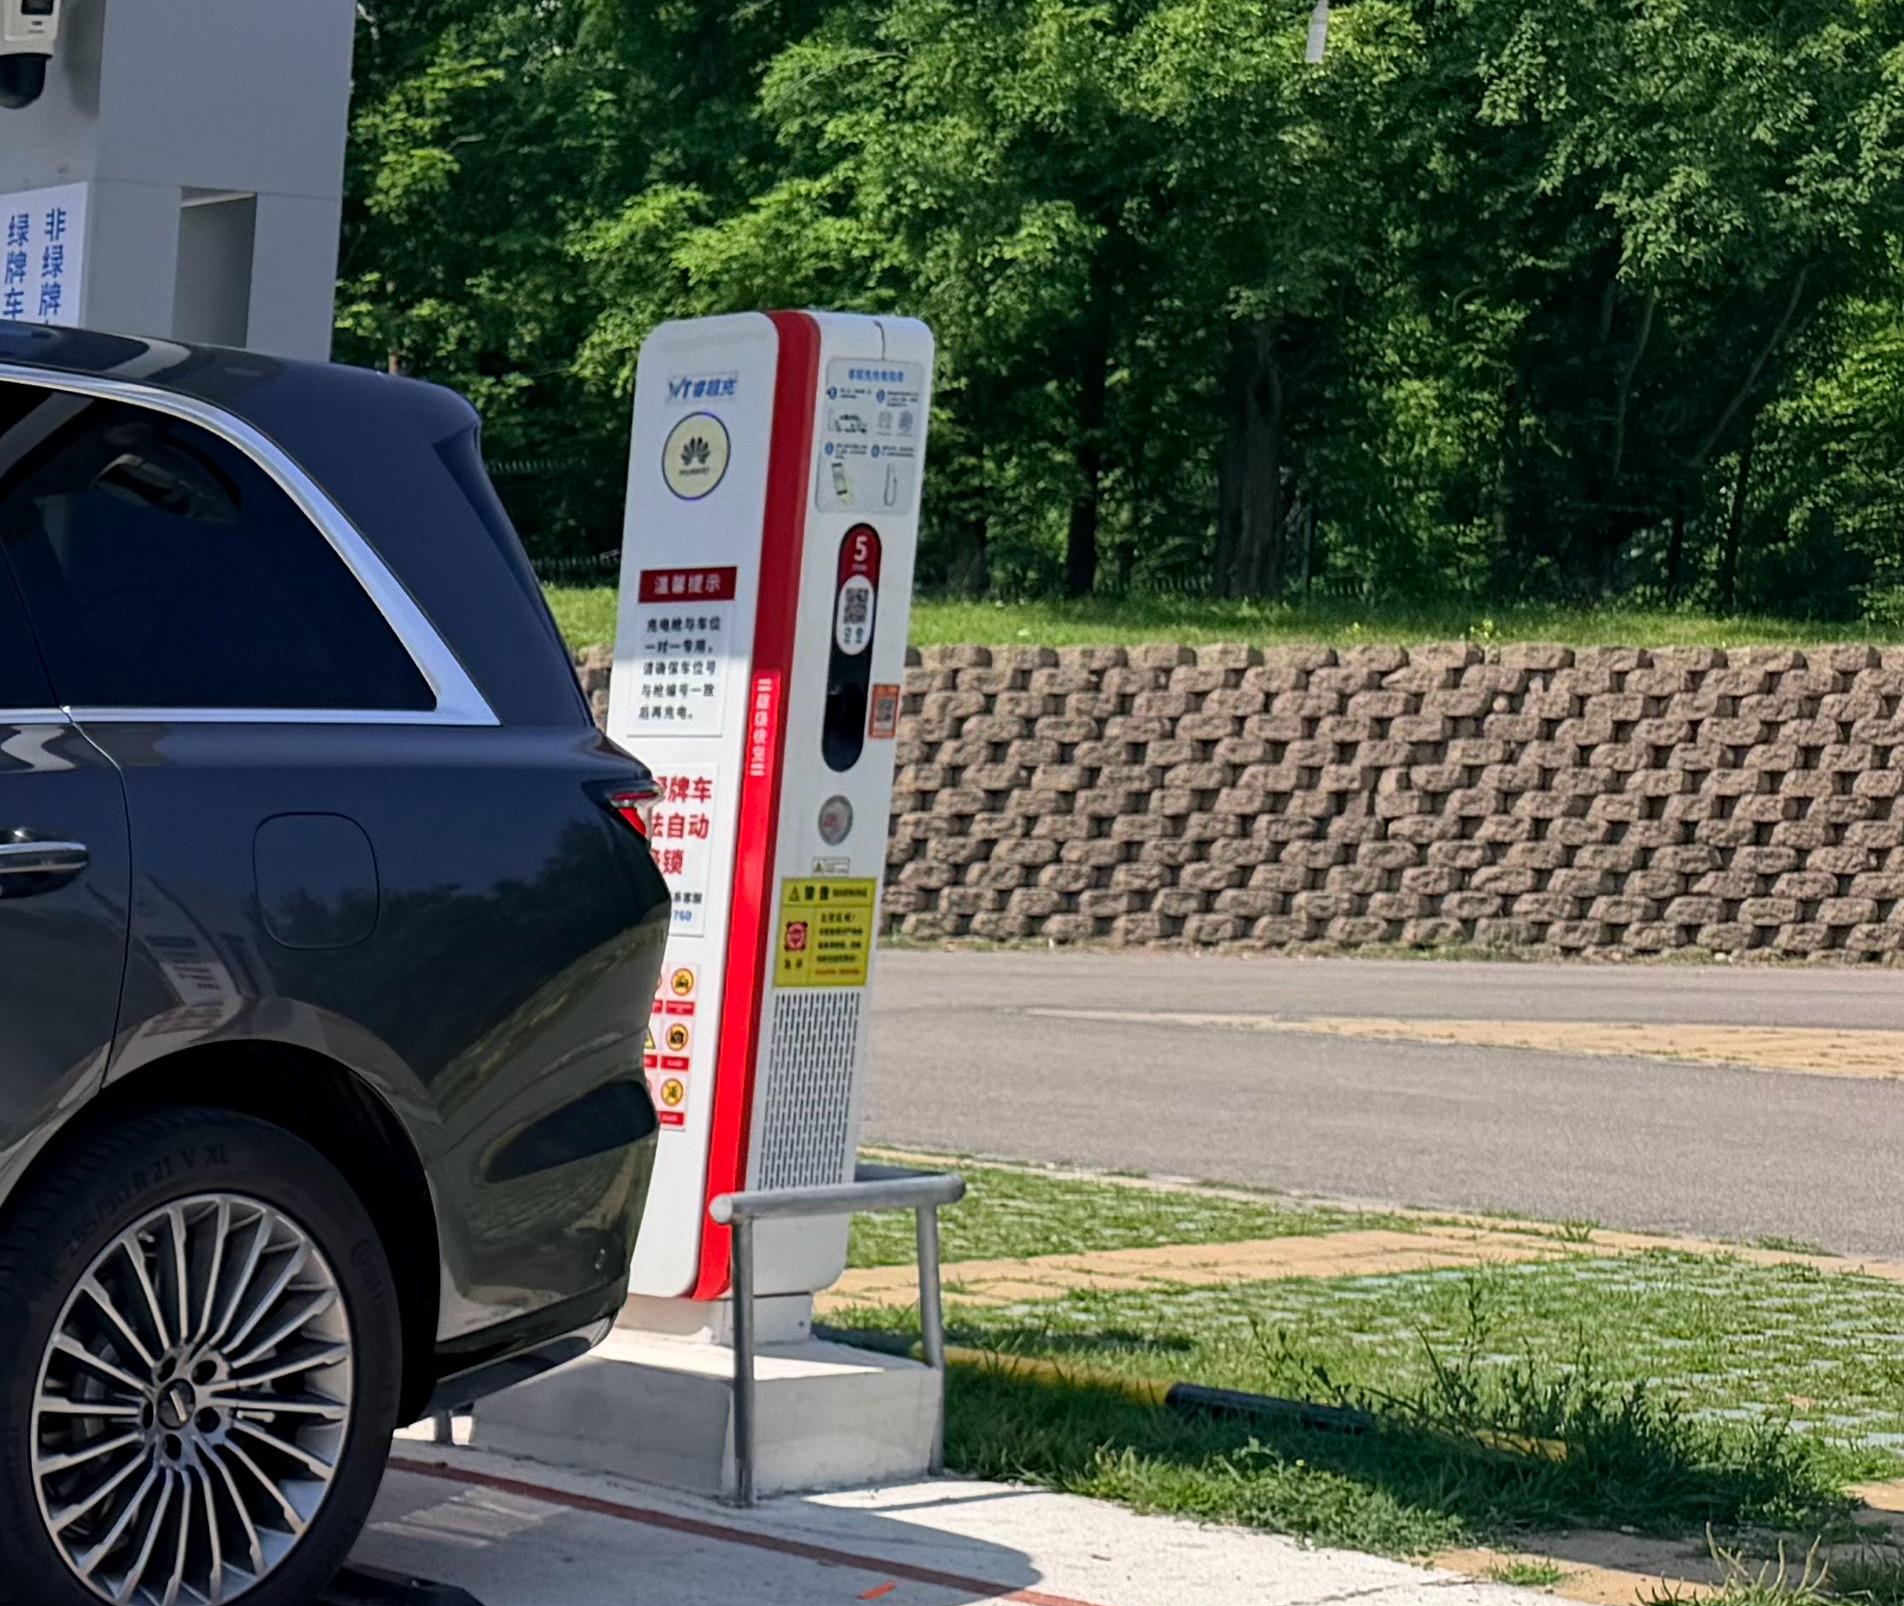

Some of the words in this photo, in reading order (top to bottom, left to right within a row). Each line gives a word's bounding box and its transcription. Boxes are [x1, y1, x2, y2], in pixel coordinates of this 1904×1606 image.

[39, 207, 67, 324] 非绿牌
[853, 535, 869, 562] 5
[654, 573, 721, 595] 温馨提示
[647, 615, 721, 633] 充电枪与车位
[643, 660, 716, 676] 请确保车位号
